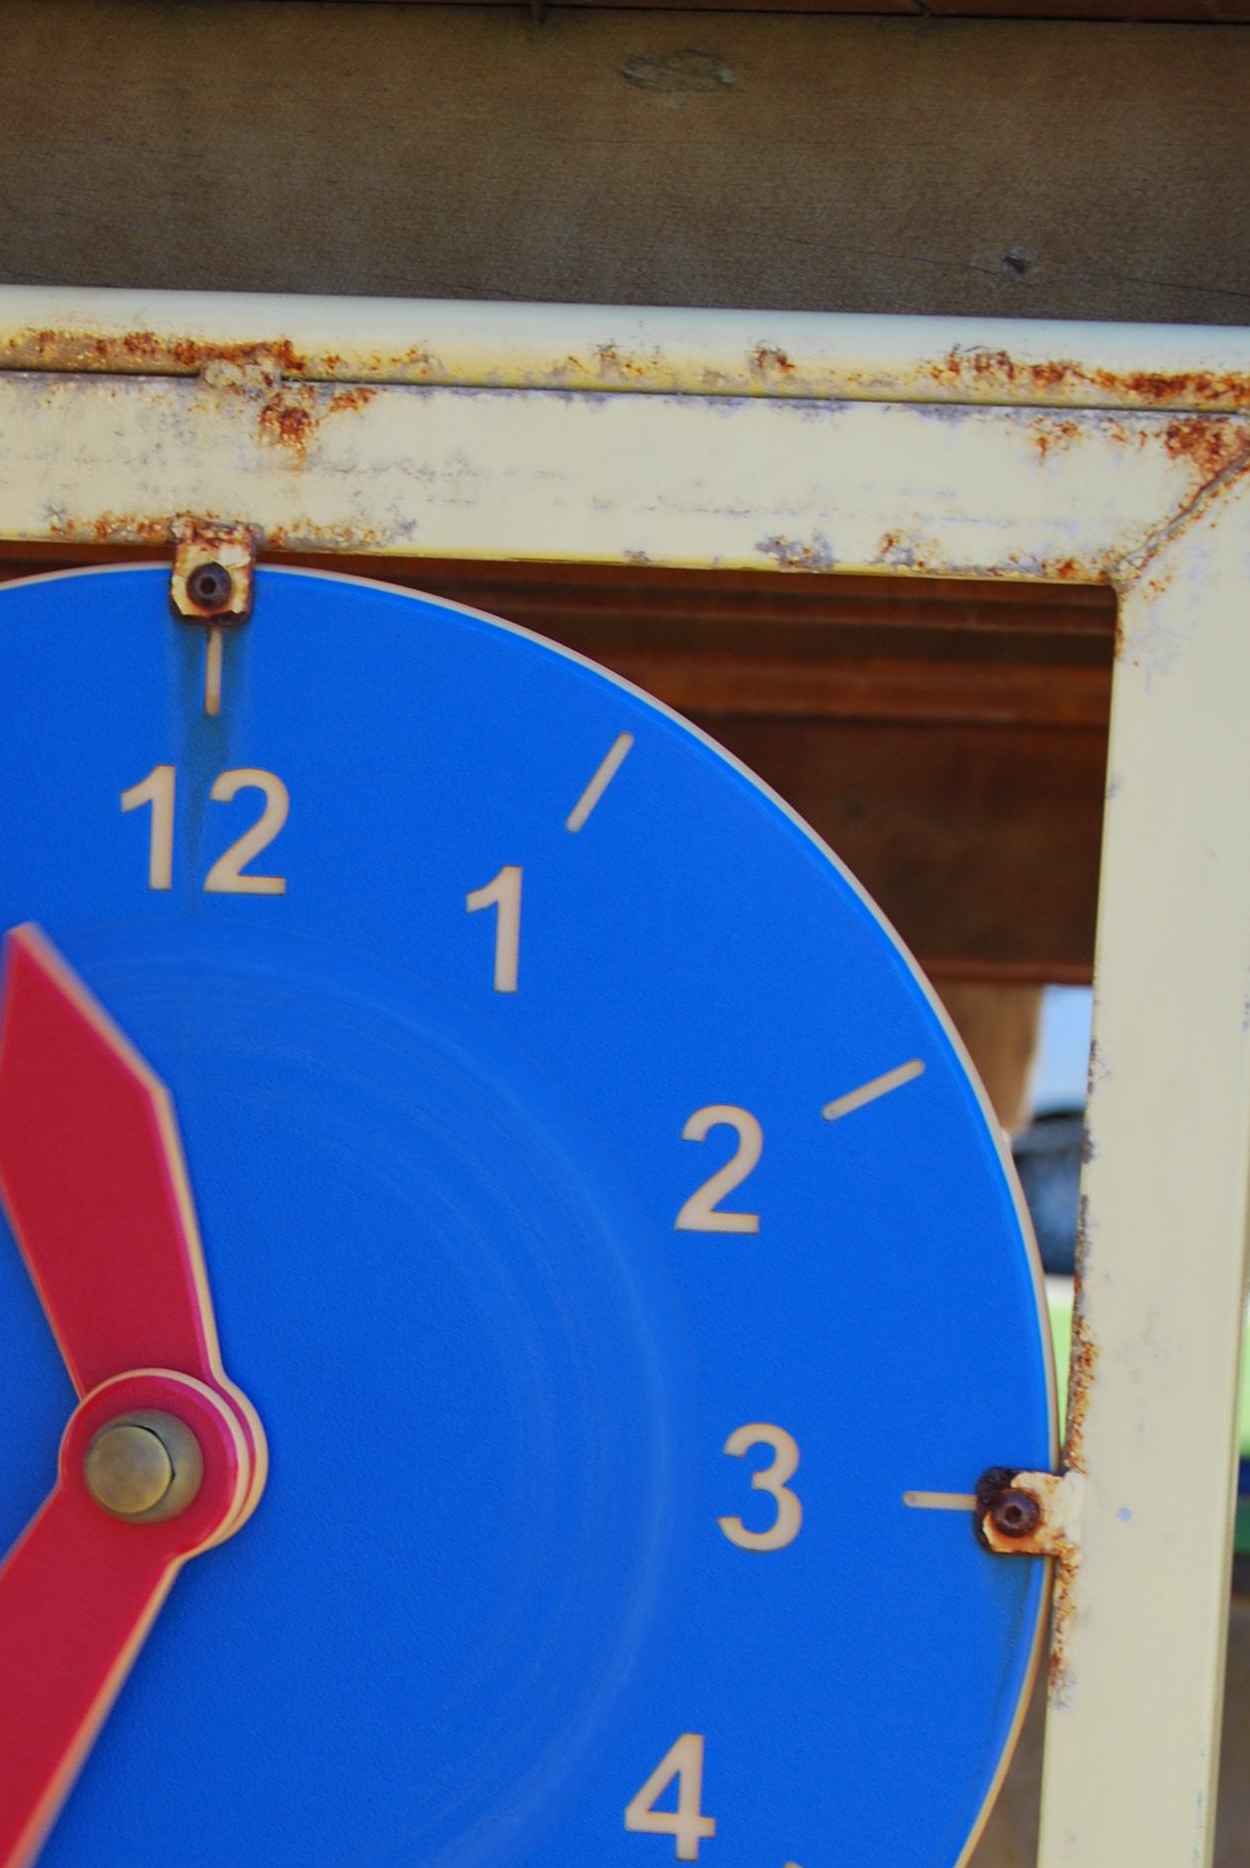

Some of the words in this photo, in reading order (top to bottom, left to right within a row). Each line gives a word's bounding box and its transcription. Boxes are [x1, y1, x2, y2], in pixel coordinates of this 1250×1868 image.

[119, 764, 290, 895] 12
[464, 865, 523, 993] 1
[674, 1103, 764, 1235] 2
[716, 1422, 803, 1553] 3
[623, 1732, 718, 1861] 4
